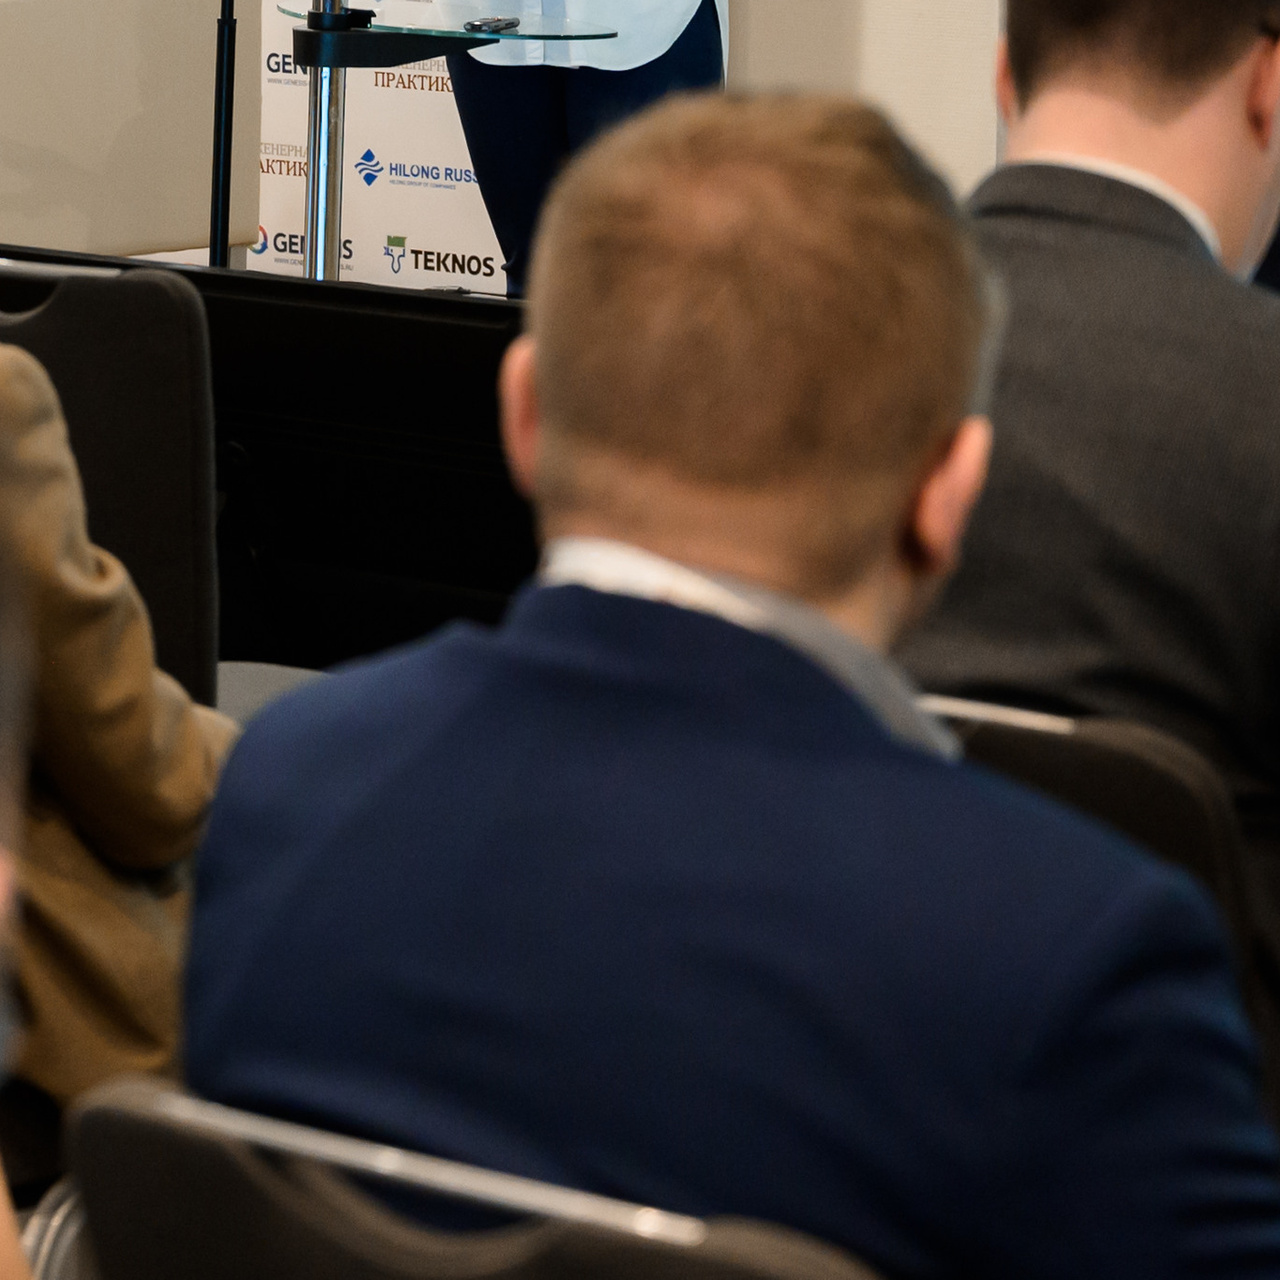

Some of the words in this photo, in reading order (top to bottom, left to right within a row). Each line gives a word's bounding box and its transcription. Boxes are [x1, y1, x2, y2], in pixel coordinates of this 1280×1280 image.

[374, 71, 454, 93] ПРАКТИК
[261, 141, 308, 158] ЕНЕРН
[260, 158, 308, 178] АКТИК
[389, 162, 440, 181] HILONG
[444, 165, 479, 184] RUSS
[411, 248, 494, 277] TEKNOS
